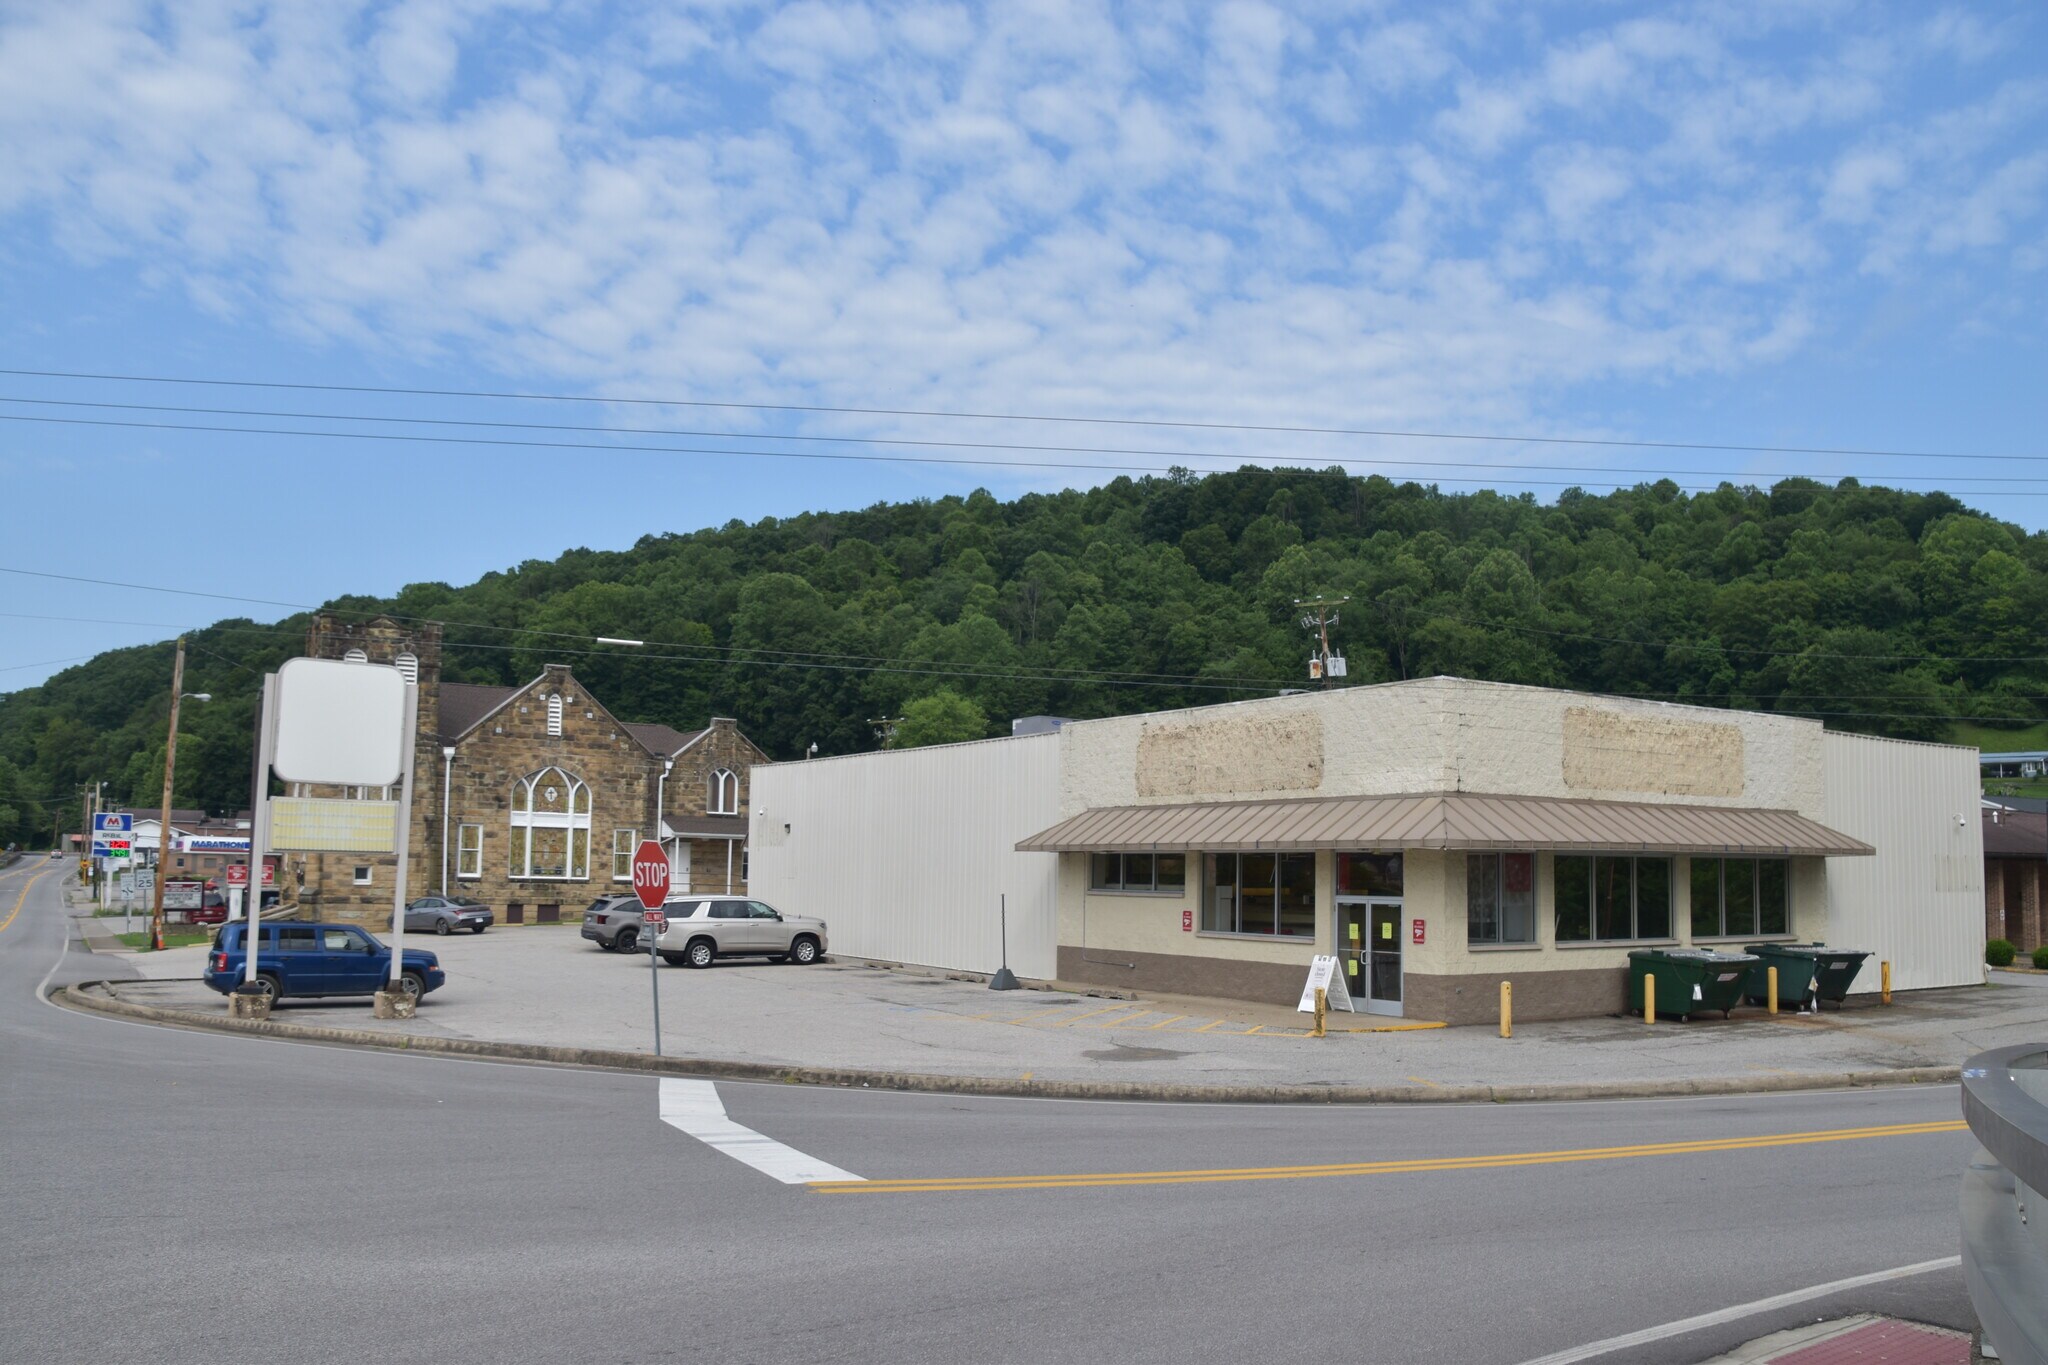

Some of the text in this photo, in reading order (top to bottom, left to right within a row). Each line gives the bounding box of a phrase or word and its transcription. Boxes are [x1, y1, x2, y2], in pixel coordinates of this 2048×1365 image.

[107, 817, 120, 825] M
[191, 840, 244, 849] MARATHON
[636, 862, 667, 887] STOP
[138, 879, 153, 888] 25
